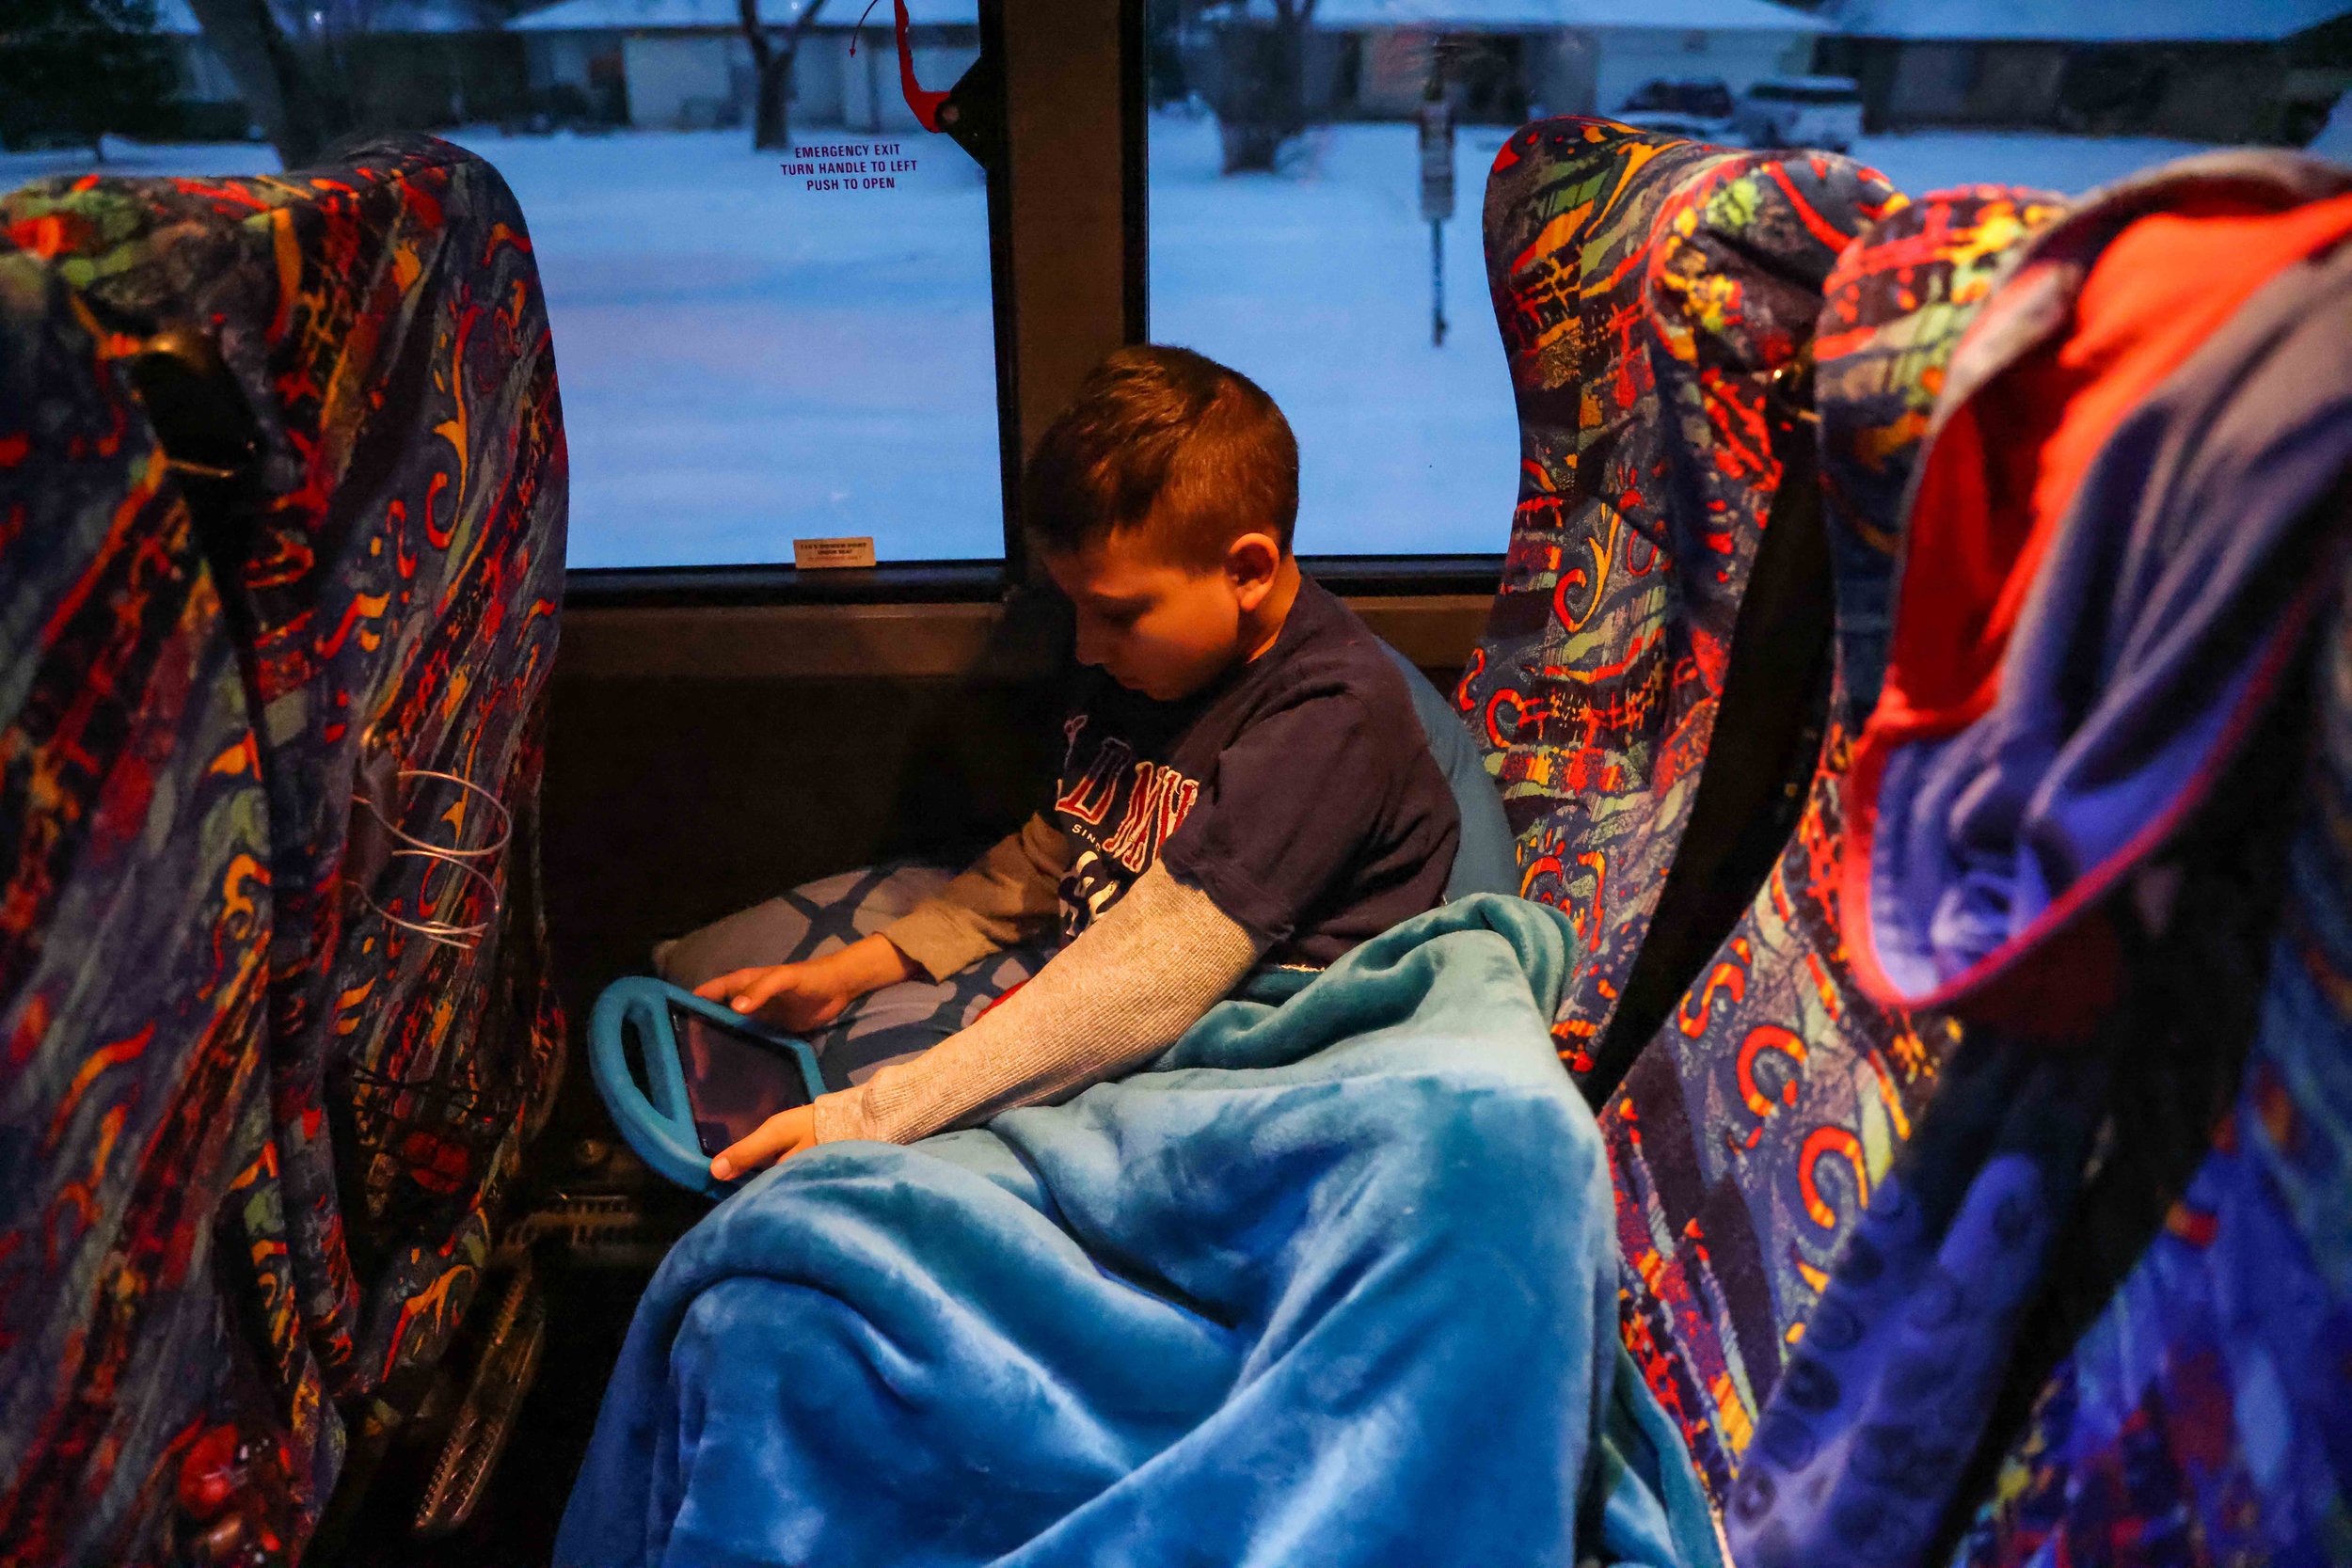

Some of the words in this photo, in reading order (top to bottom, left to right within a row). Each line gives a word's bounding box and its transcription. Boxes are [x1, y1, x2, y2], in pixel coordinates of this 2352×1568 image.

[795, 145, 869, 158] EMERGENCY
[874, 144, 900, 156] EXIT
[781, 163, 815, 176] TURN
[818, 161, 866, 174] HANDLE
[870, 161, 886, 172] TO
[890, 160, 917, 172] LEFT
[806, 179, 839, 191] PUSH
[843, 178, 858, 190] TO
[863, 177, 895, 189] OPEN
